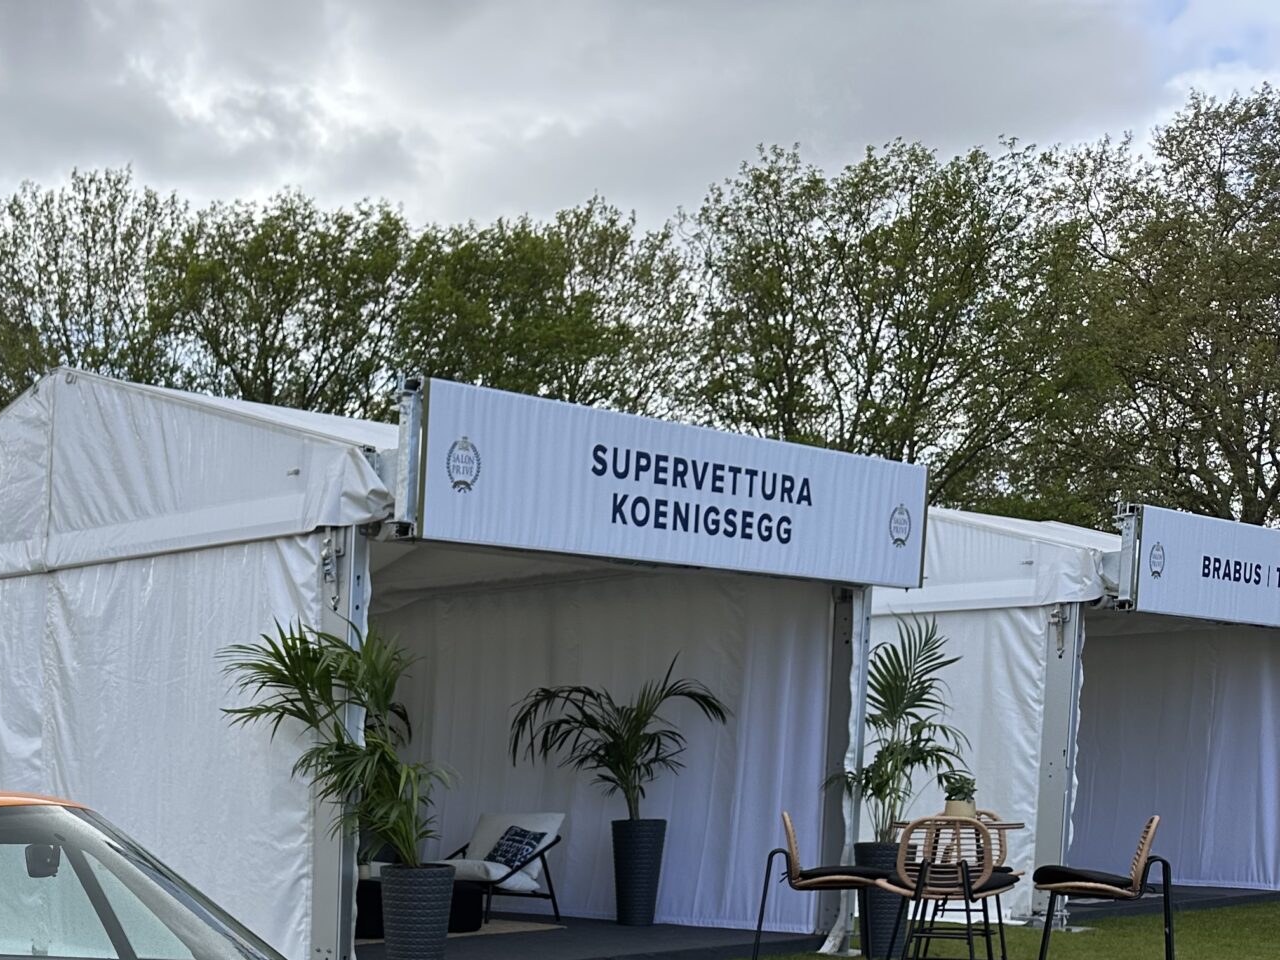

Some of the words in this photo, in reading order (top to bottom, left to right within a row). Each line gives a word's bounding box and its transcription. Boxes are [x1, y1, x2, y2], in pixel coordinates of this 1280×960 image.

[591, 444, 812, 506] SUPERVETTURA
[611, 492, 792, 544] KOENIGSEGG
[1202, 555, 1262, 585] BRABUS
